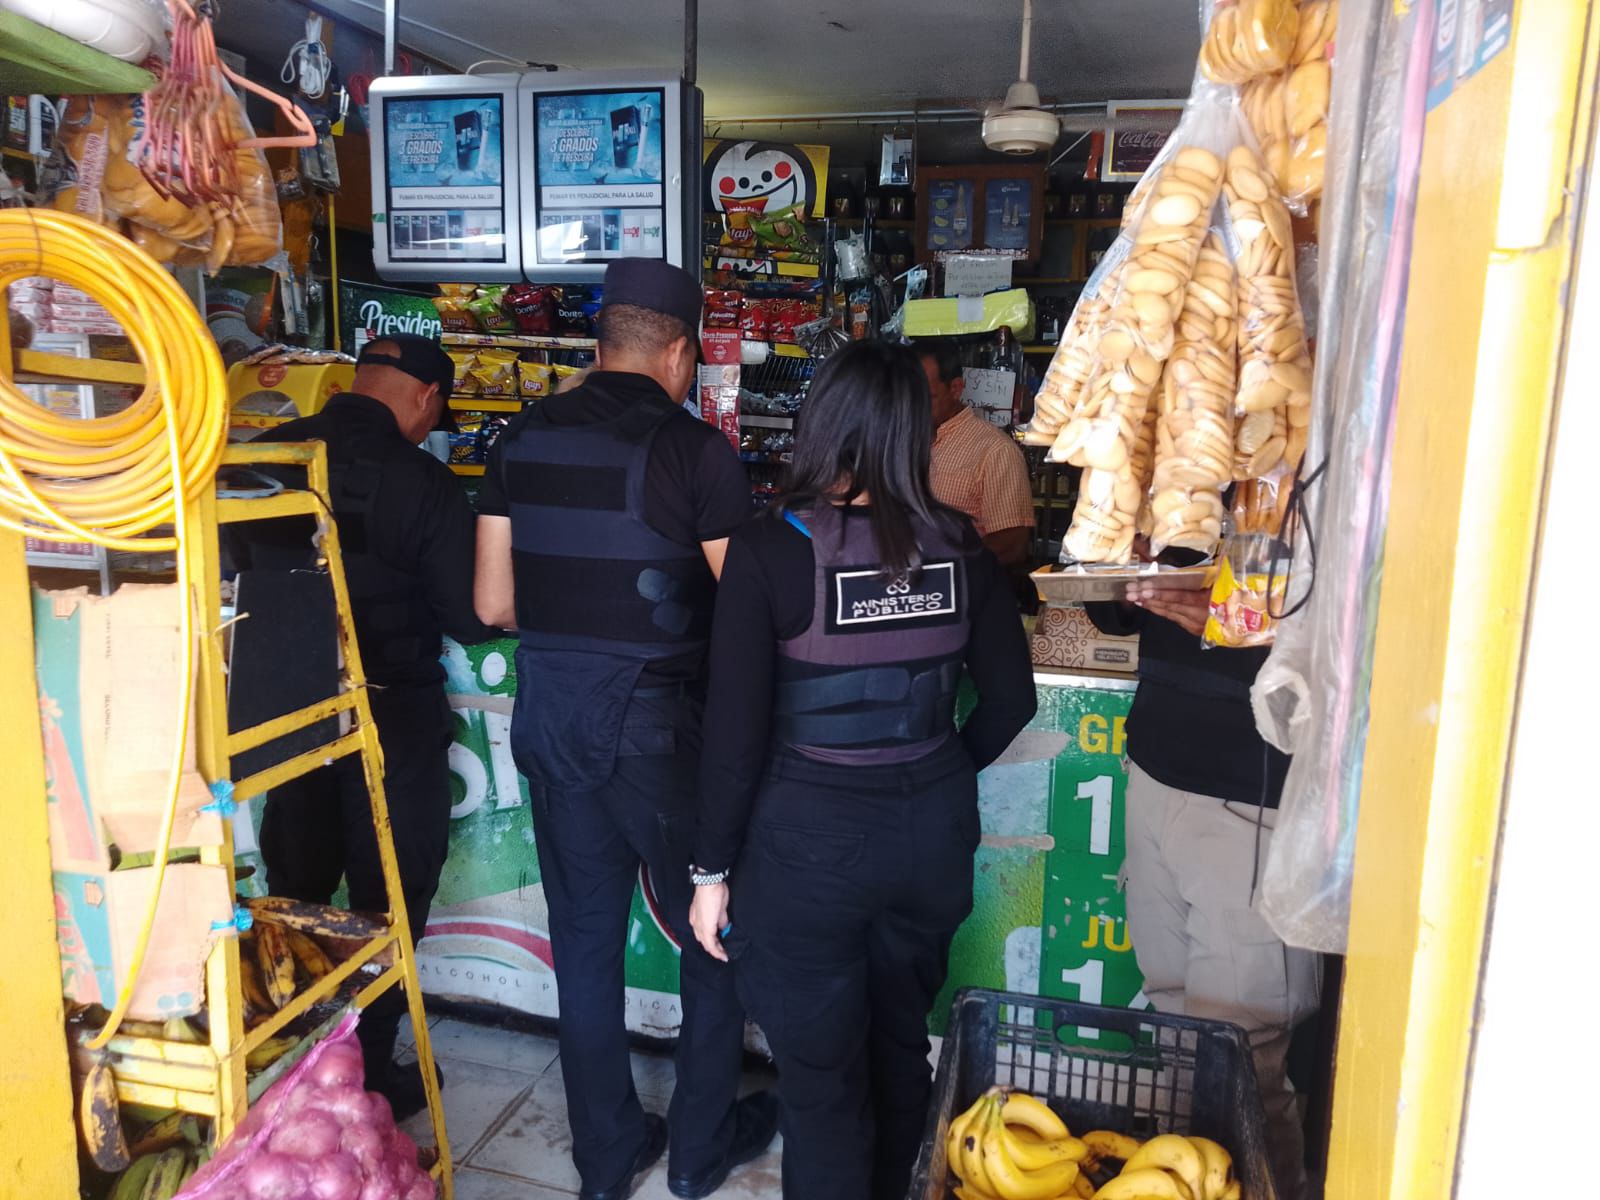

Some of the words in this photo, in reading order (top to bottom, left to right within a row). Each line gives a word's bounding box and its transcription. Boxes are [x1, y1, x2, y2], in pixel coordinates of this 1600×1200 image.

[406, 140, 443, 154] GRADOS
[551, 139, 557, 152] 3
[559, 137, 599, 152] GRADOS
[635, 191, 653, 199] SALUD
[360, 300, 441, 340] Presiden
[852, 592, 943, 609] MINISTERIO
[853, 601, 941, 618] PUBLICO
[420, 964, 521, 987] ALCOHOL
